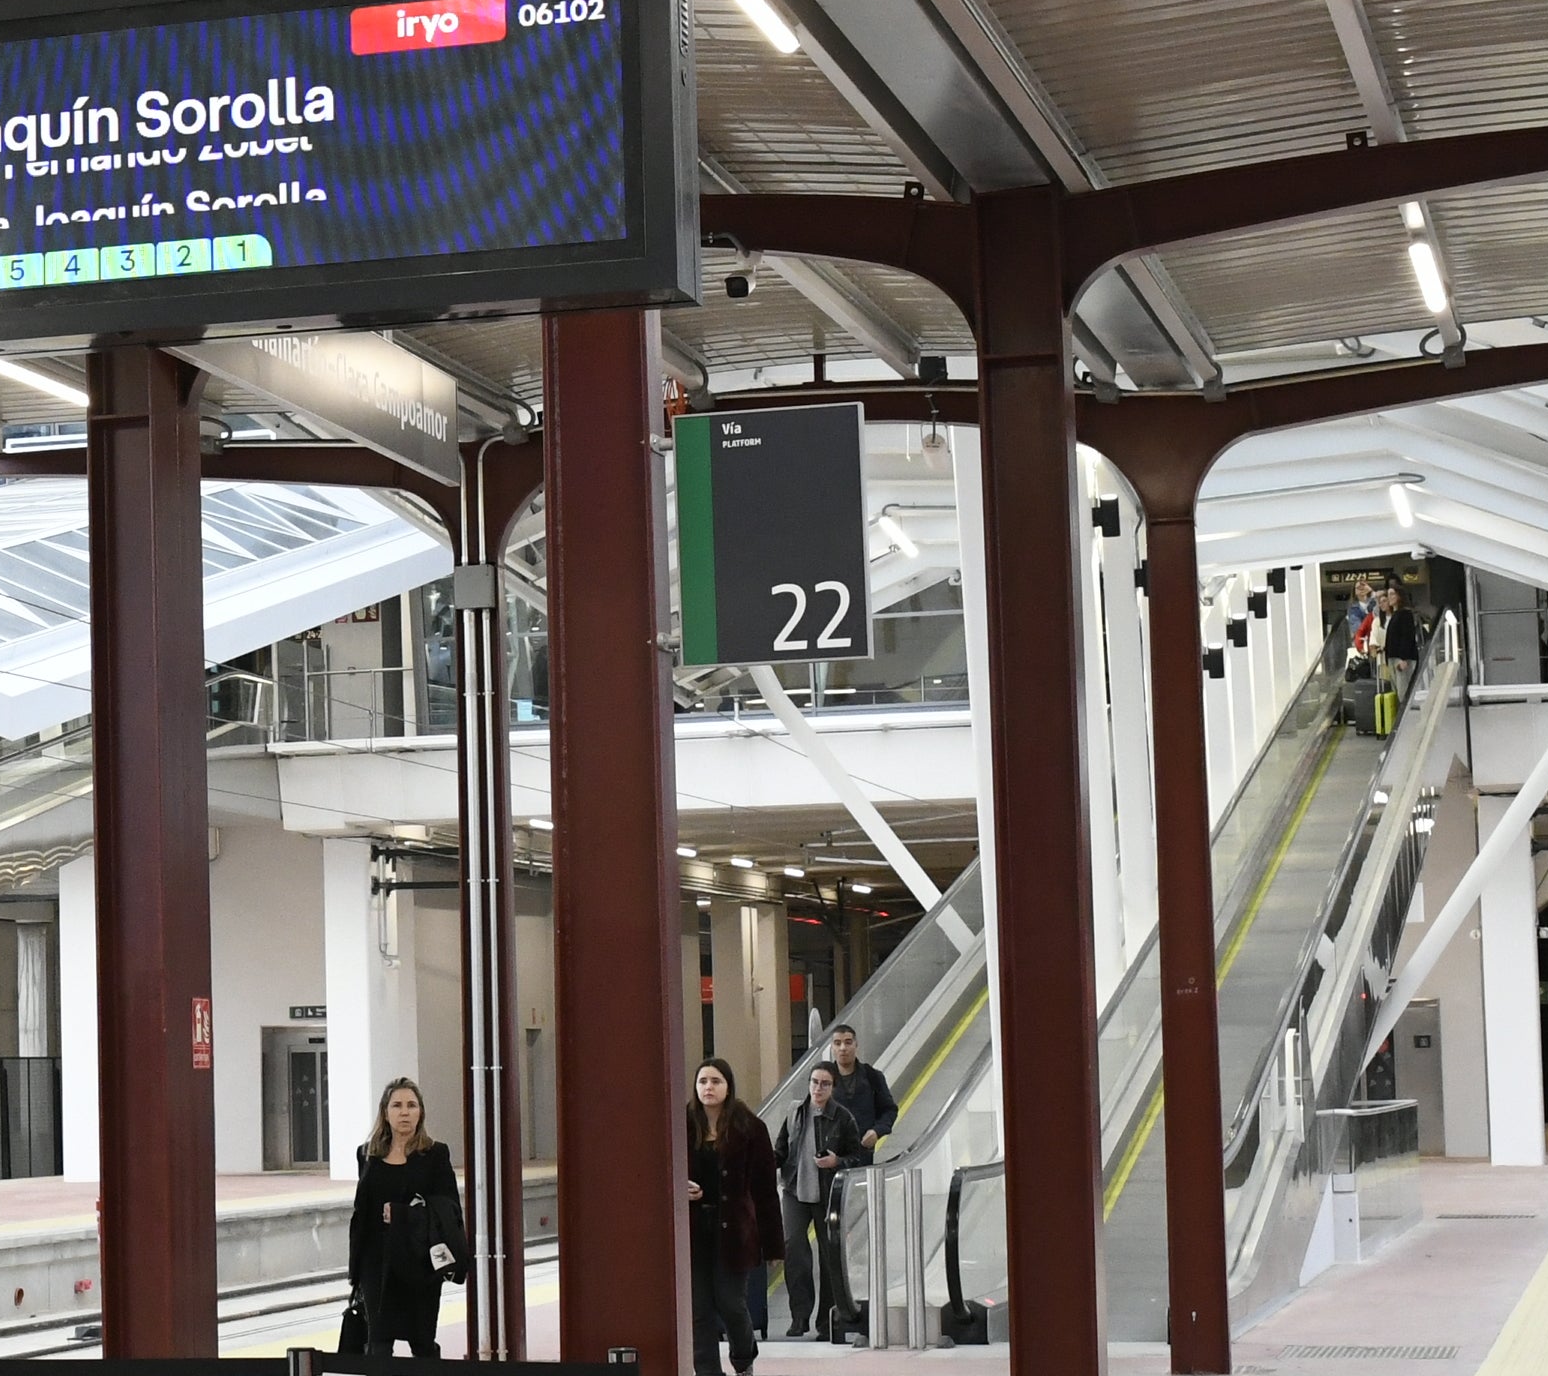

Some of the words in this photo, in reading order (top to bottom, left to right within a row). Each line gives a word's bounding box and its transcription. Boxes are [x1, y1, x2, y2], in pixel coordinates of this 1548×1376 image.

[396, 9, 459, 43] iryo
[135, 77, 335, 138] Sorolla
[10, 259, 24, 280] 5
[65, 255, 80, 275] 4
[120, 249, 135, 271] 3
[177, 245, 192, 267] 2
[237, 239, 246, 261] 1
[722, 422, 742, 435] Vía
[722, 437, 761, 449] PLATFORM
[771, 580, 852, 651] 22
